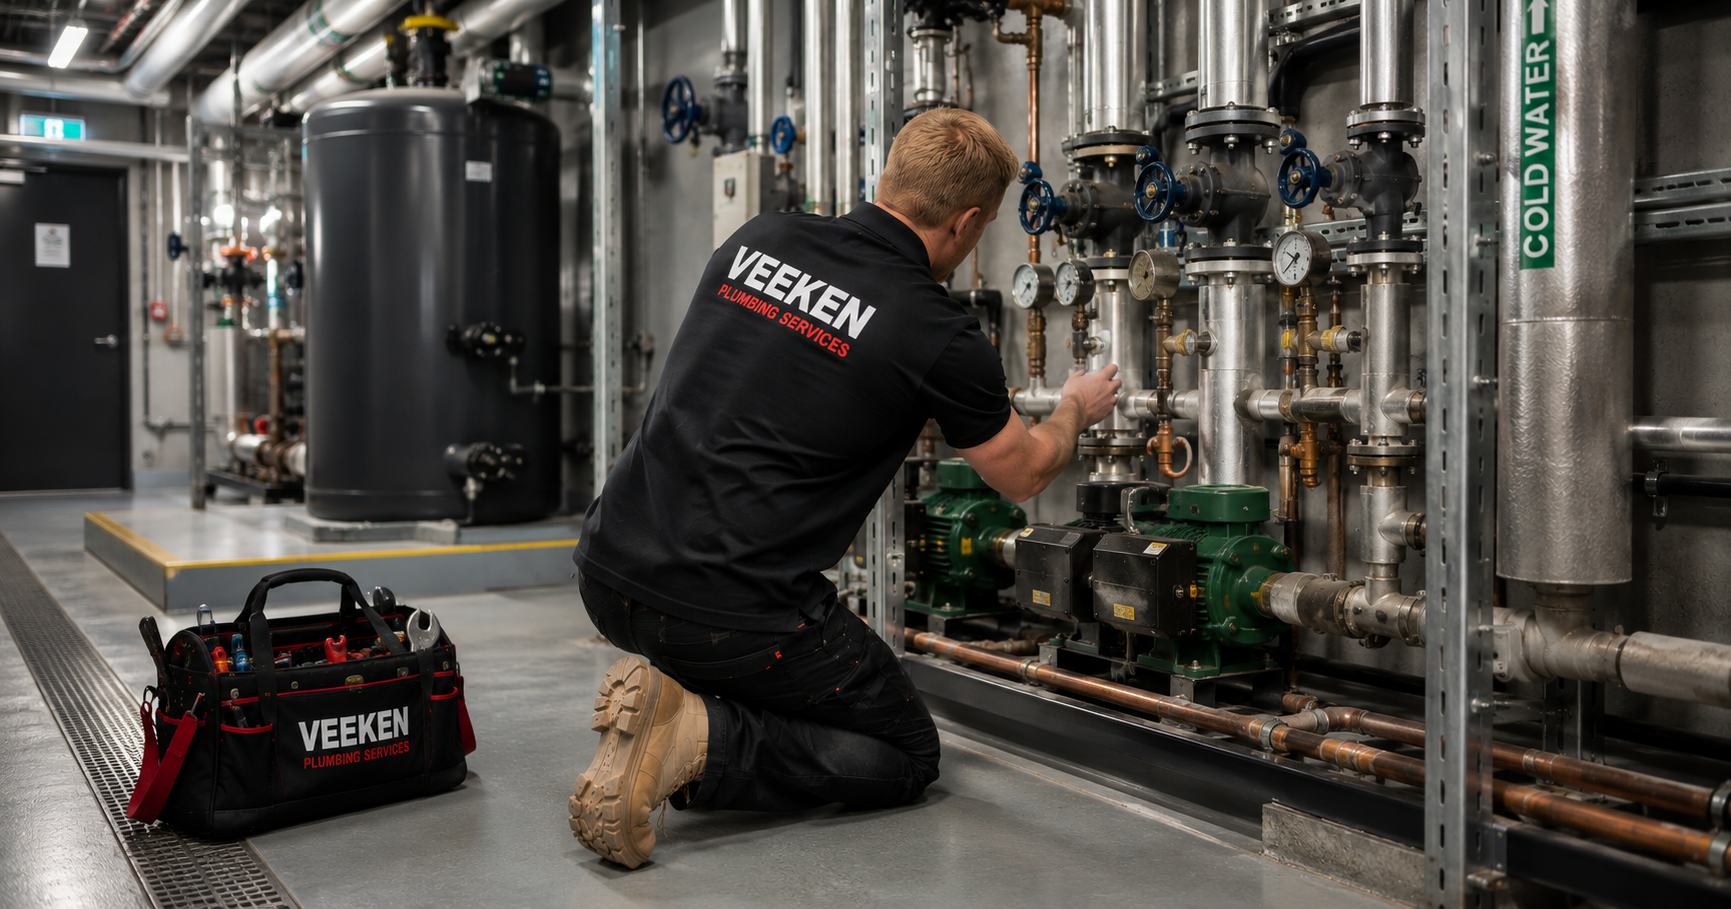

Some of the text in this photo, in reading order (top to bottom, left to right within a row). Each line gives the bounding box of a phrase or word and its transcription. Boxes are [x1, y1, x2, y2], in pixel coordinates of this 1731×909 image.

[1523, 40, 1550, 258] COLD WATER
[717, 283, 851, 358] PLUMBING SERVICES
[727, 245, 877, 340] VEEKEN
[298, 706, 409, 752] VEEKEN
[303, 740, 410, 770] PLUMBING SERVICES
